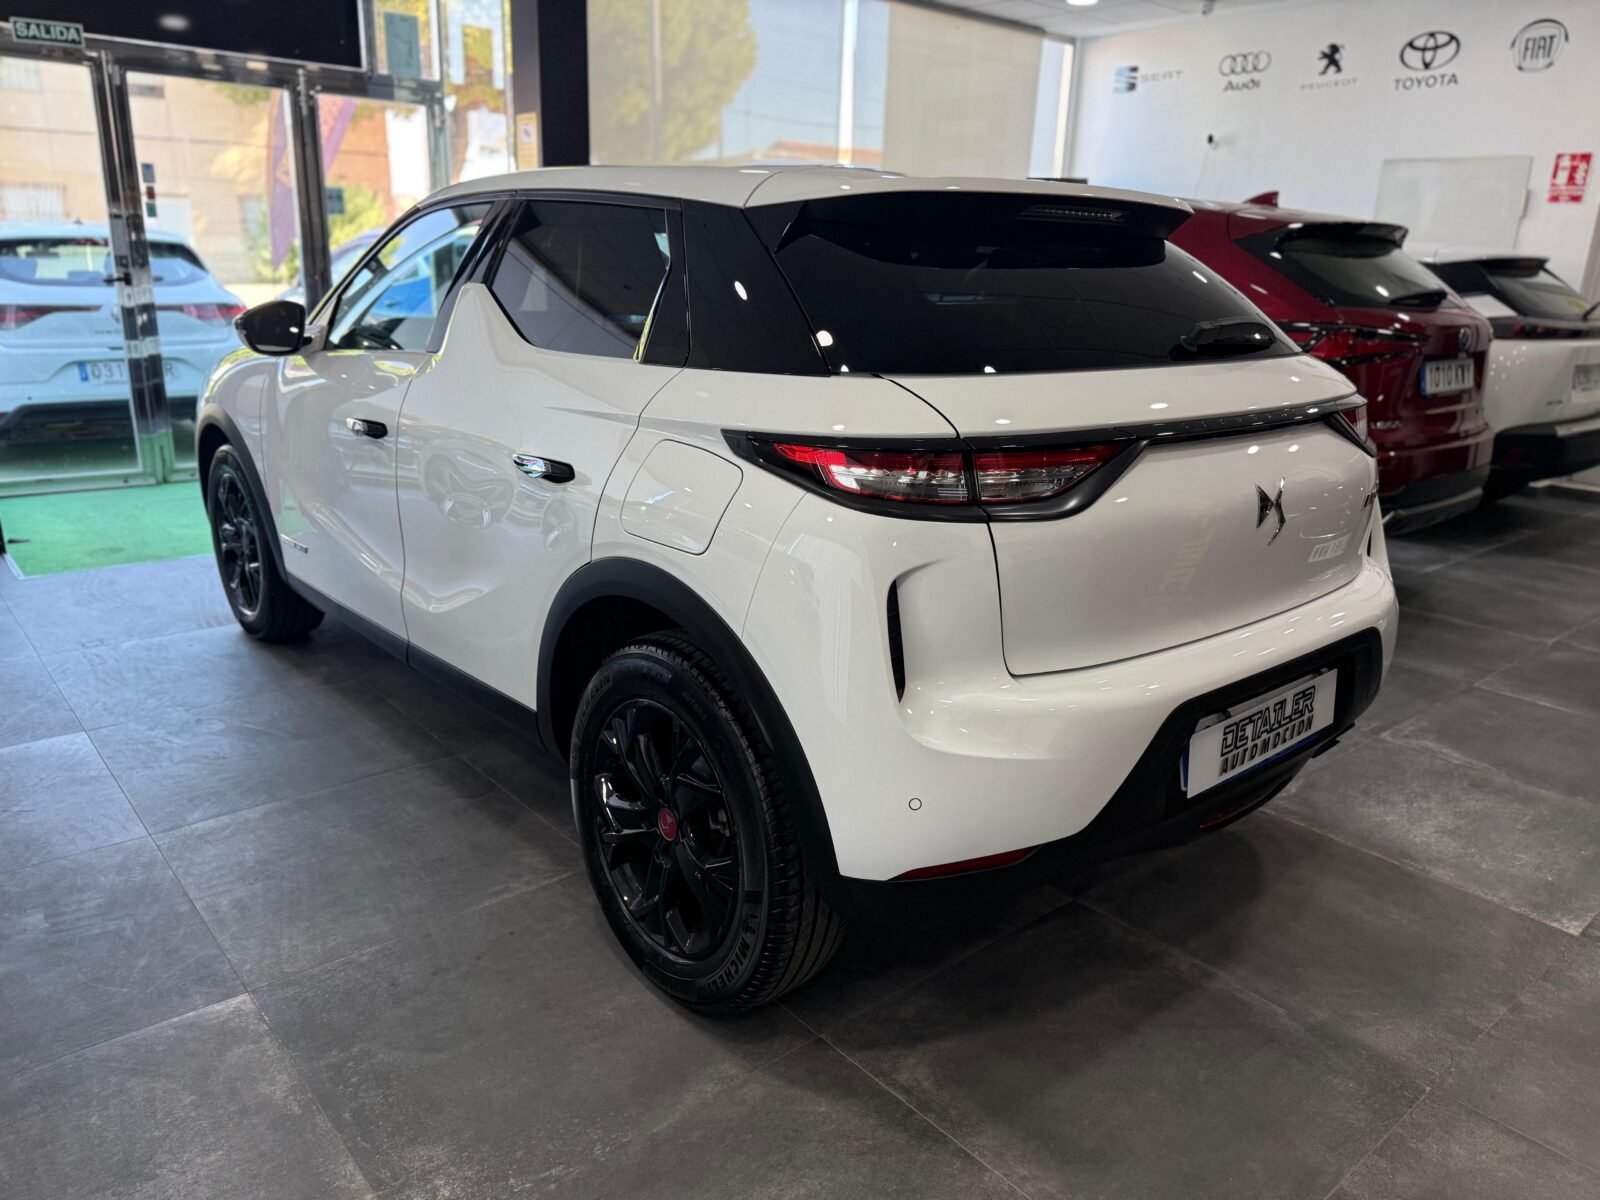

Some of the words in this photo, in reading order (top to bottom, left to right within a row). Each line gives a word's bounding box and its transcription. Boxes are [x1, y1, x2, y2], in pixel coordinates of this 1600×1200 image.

[15, 21, 80, 42] SALIDA
[1522, 34, 1557, 60] FIAT
[1140, 70, 1184, 84] SEAT
[1223, 78, 1261, 93] Audi
[1394, 73, 1458, 91] TOYOTA
[1220, 685, 1316, 758] DETAILER
[1218, 713, 1314, 777] AUTOMOCION
